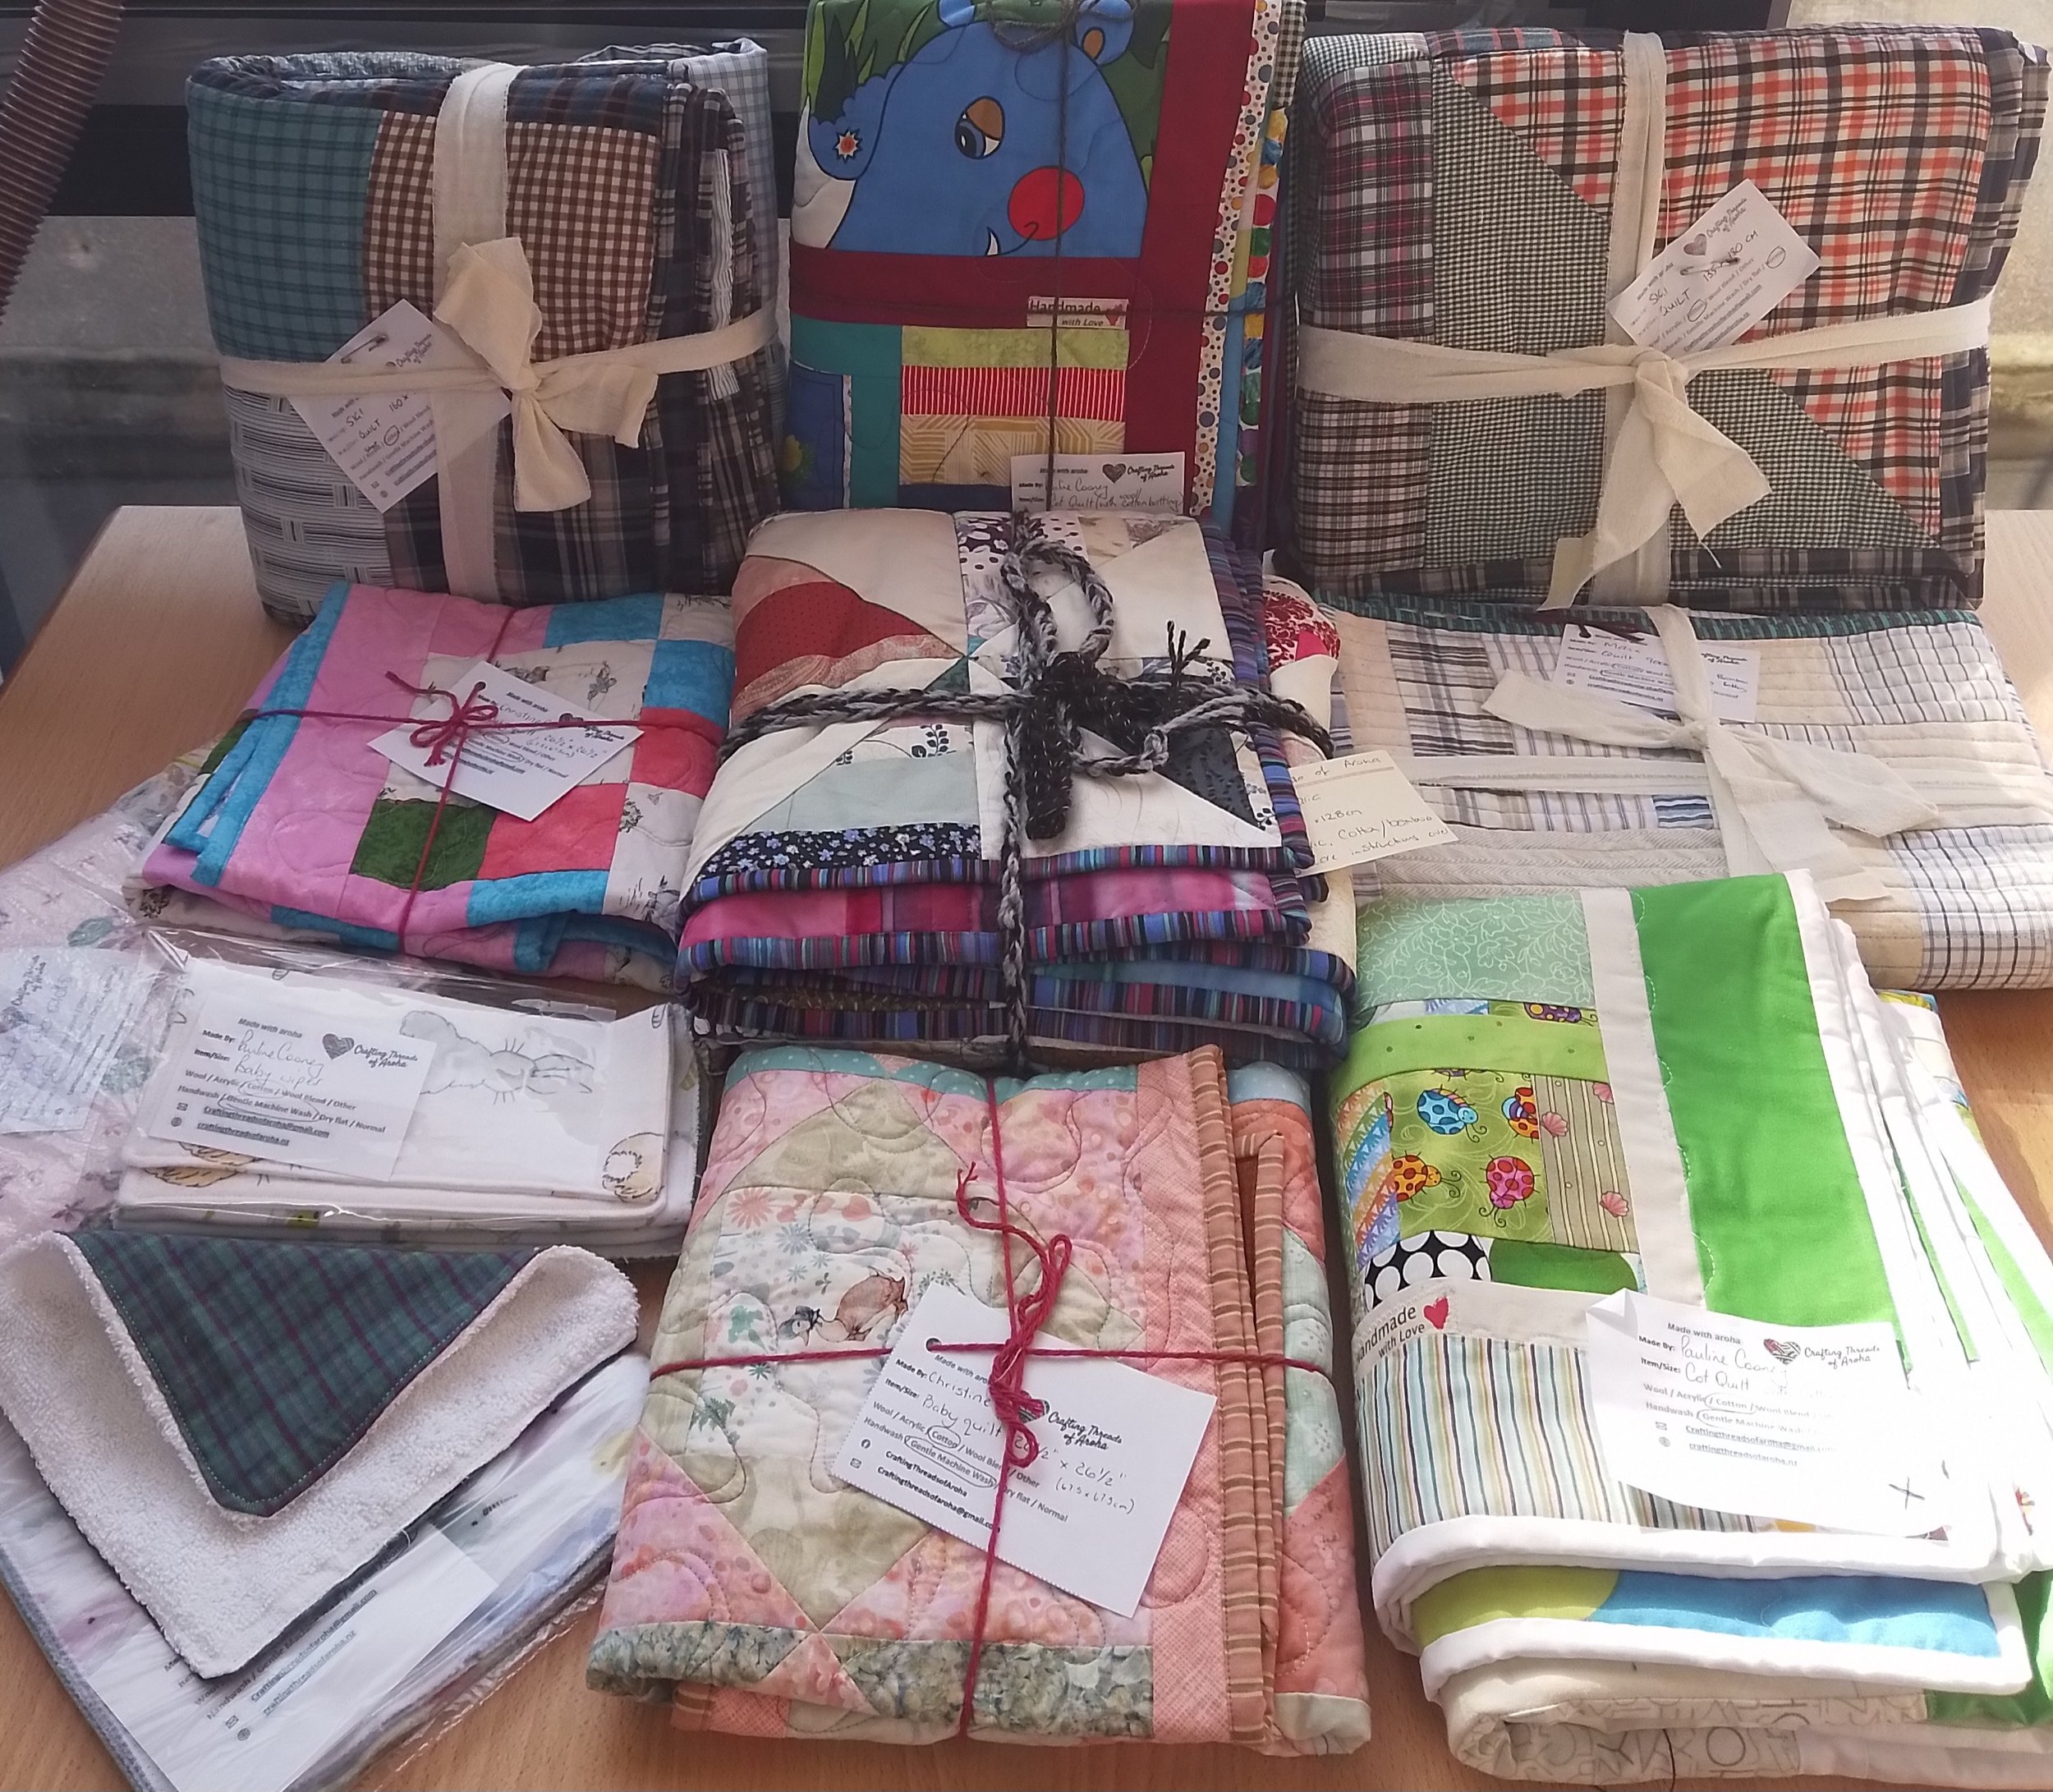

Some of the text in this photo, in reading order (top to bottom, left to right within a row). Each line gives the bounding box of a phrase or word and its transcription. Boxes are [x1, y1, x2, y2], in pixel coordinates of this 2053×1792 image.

[1084, 318, 1104, 327] Love
[201, 1029, 223, 1040] Made
[223, 1035, 235, 1044] By:
[237, 1018, 302, 1039] Made with aroha
[194, 1048, 230, 1063] Item/Size:
[353, 1043, 417, 1064] Crafting Threads
[367, 1056, 408, 1071] of Aroha
[184, 1069, 206, 1080] Wool
[213, 1076, 239, 1088] Acrylic
[281, 1088, 302, 1100] Wool
[304, 1093, 326, 1104] Blend
[333, 1100, 356, 1110] Other
[177, 1084, 385, 1133] Handwash Gentle Machine Wash Dry flat Normal
[1357, 1307, 1417, 1362] andmade
[1379, 1324, 1425, 1358] with Love
[1668, 1321, 1741, 1345] Made with aroha
[1637, 1335, 1661, 1347] Made
[1661, 1341, 1675, 1351] By:
[1679, 1335, 1730, 1365] Pauline
[1803, 1345, 1842, 1362] Crafting
[1827, 1353, 1871, 1369] of Aroha
[894, 1358, 916, 1373] Made
[915, 1368, 928, 1380] By:
[934, 1353, 957, 1369] Made
[956, 1365, 974, 1377] with
[1639, 1357, 1750, 1391] Item/Size: Cot Quilt
[1642, 1383, 1668, 1395] Wool
[1676, 1390, 1706, 1404] Acrylic
[1715, 1398, 1747, 1409] Cotton
[1757, 1405, 1780, 1413] Wool
[884, 1378, 920, 1399] Item/Size:
[917, 1394, 962, 1431] Baby
[958, 1412, 1004, 1448] quilt
[1646, 1402, 1693, 1417] Handwash
[1702, 1413, 1732, 1423] Gentle
[1734, 1418, 1775, 1430] Machine
[1046, 1409, 1123, 1448] Crafting Threads
[1061, 1431, 1109, 1455] of Aroha
[871, 1401, 894, 1416] Wool
[898, 1414, 925, 1432] Acrylic
[930, 1430, 959, 1449] Cotton
[963, 1446, 987, 1463] Wool
[1015, 1472, 1040, 1488] Other
[862, 1417, 904, 1440] Handwash
[909, 1439, 937, 1458] Gentle
[935, 1453, 971, 1475] Machine
[971, 1471, 994, 1486] Wash
[1015, 1491, 1031, 1505] flat
[1036, 1502, 1068, 1522] Normal
[885, 1450, 968, 1497] CraftingThreadsofAroha
[877, 1465, 1000, 1533] Craftingthreadsofaroha@gmail.co
